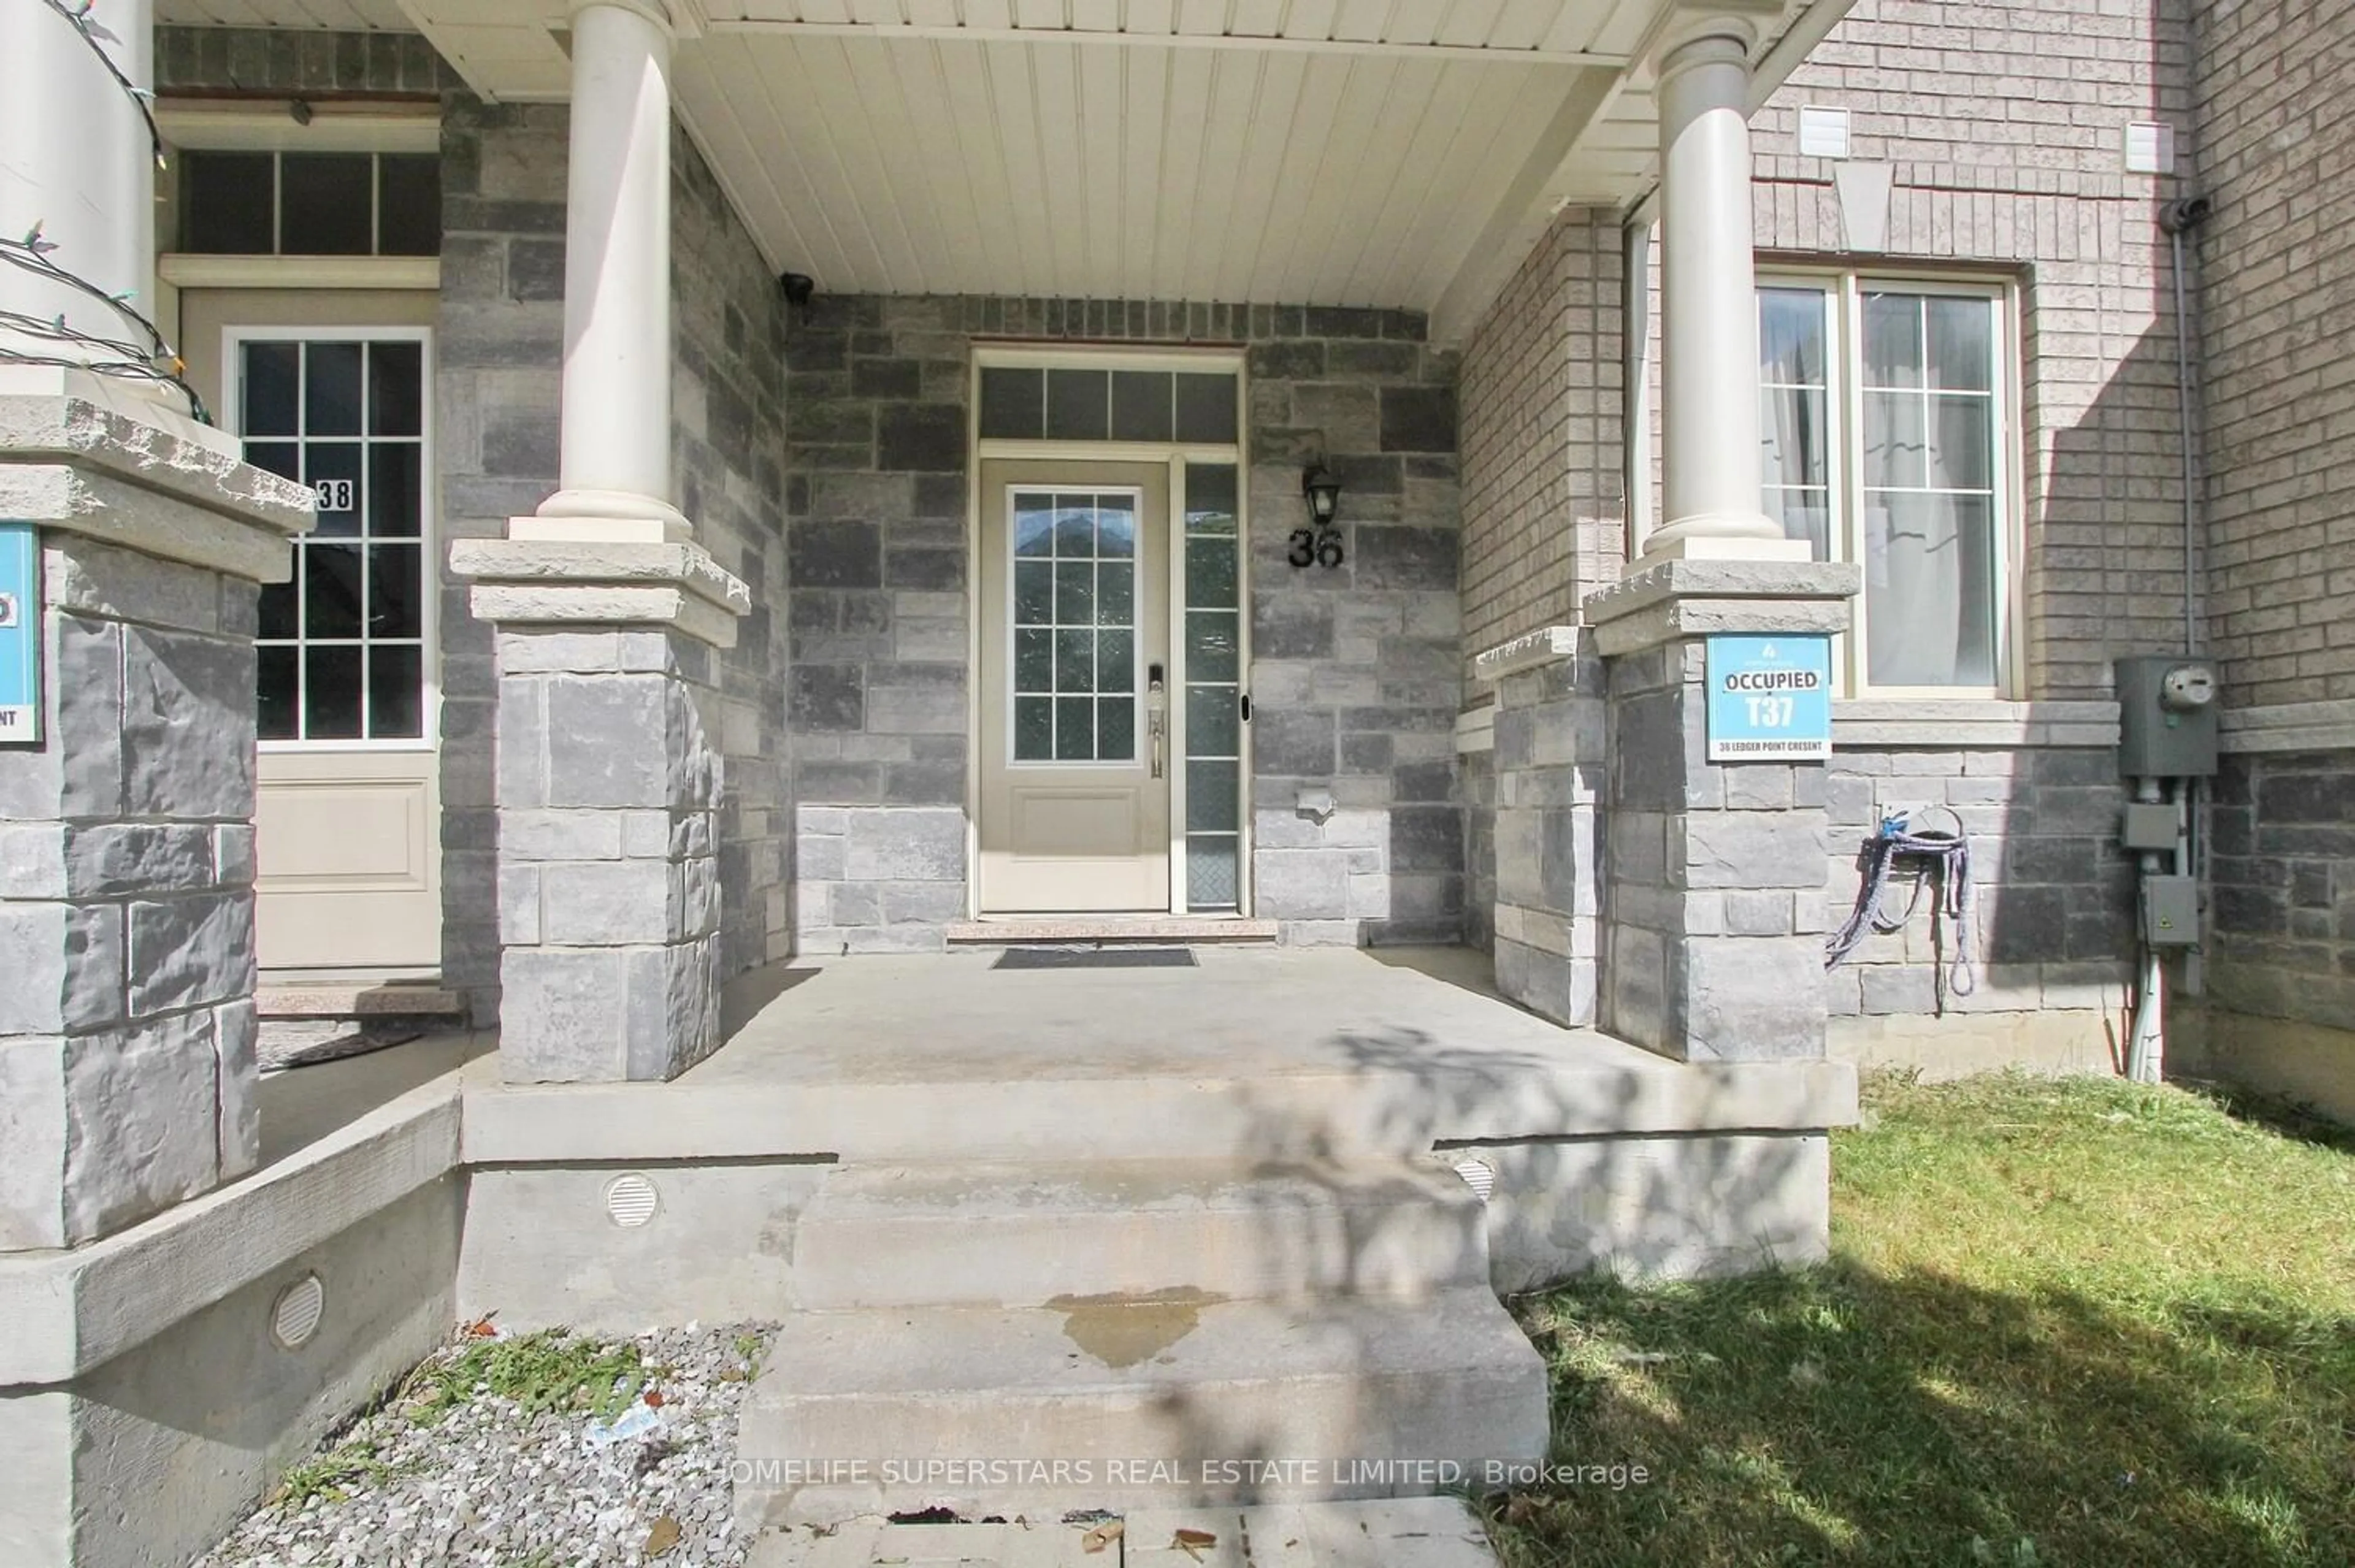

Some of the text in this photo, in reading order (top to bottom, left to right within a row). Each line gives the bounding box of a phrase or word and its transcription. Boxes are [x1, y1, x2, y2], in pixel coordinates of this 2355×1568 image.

[319, 482, 350, 508] 38
[1289, 529, 1343, 568] 36
[1725, 672, 1817, 690] OCCUPIED
[1744, 697, 1794, 729] T37
[1732, 742, 1761, 751] LEDGER
[1763, 741, 1786, 751] POINT
